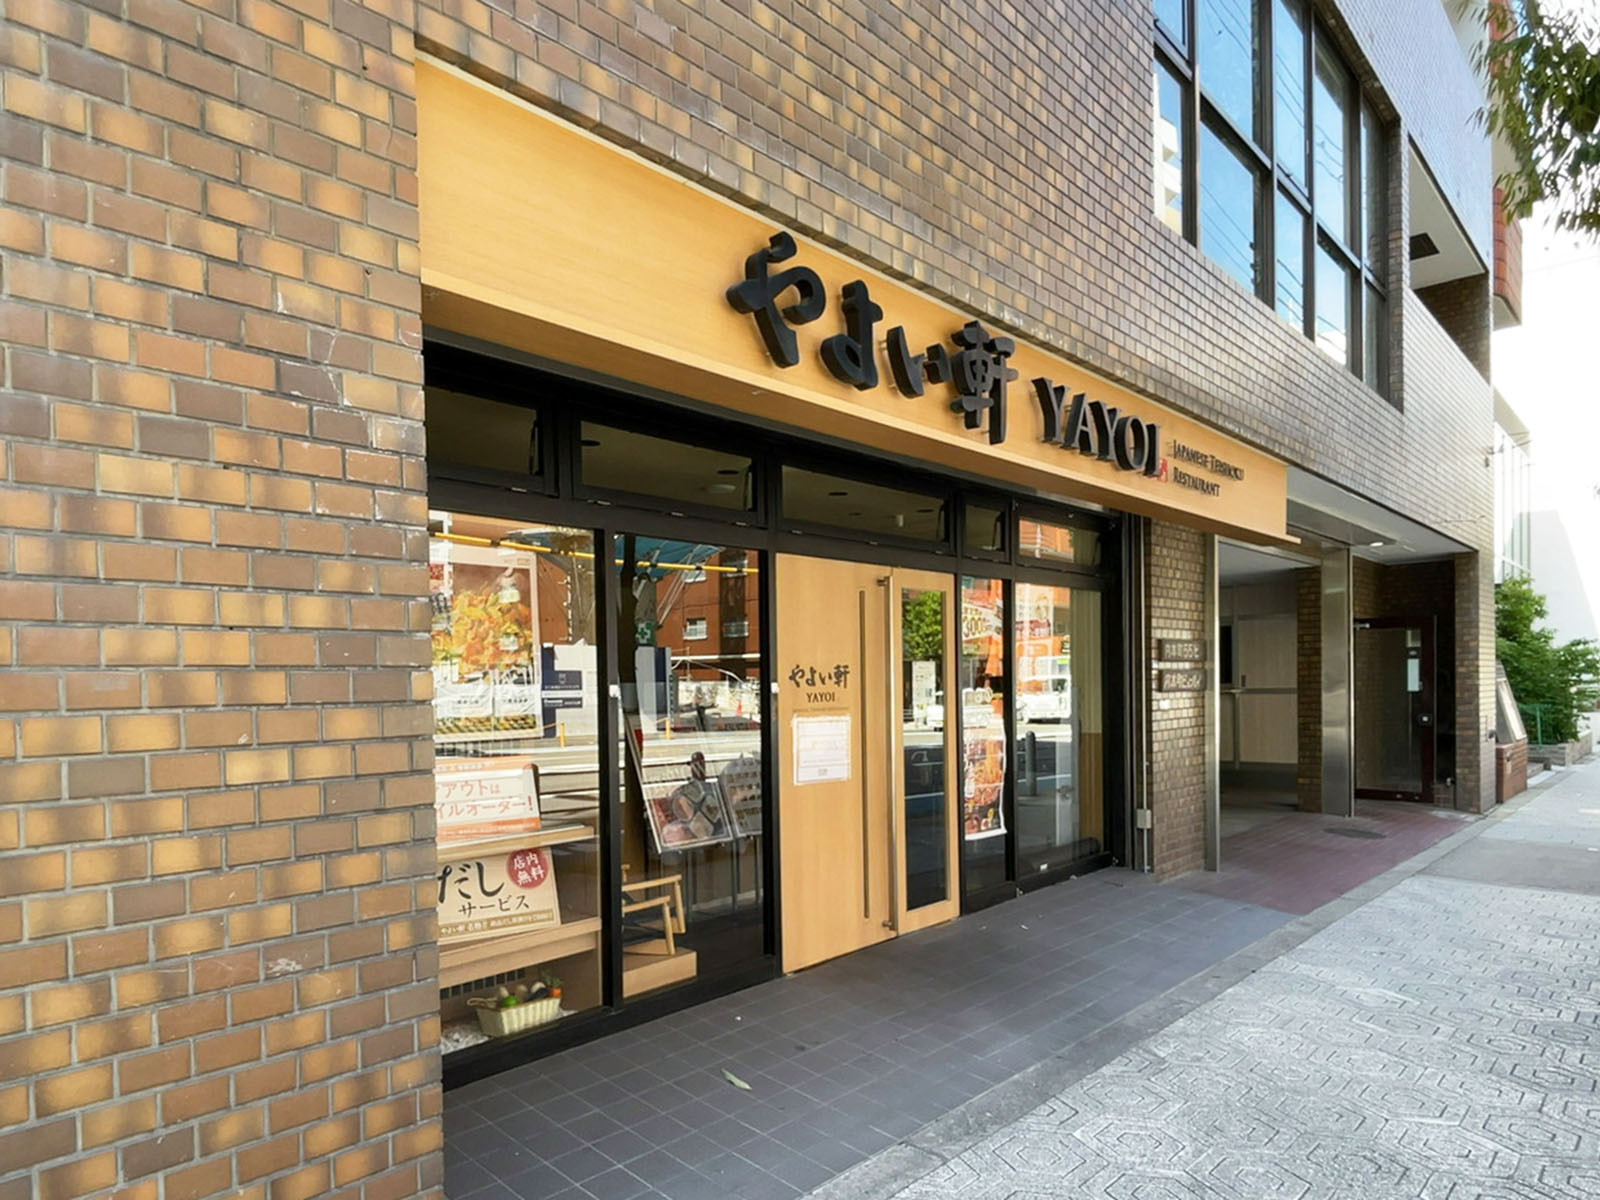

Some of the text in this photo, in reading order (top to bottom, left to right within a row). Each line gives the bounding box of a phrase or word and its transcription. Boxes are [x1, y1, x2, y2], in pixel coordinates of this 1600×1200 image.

[726, 230, 1019, 445] やよい軒
[1032, 376, 1162, 478] YAYOI
[1172, 440, 1208, 468] JAPANESE
[1172, 466, 1221, 497] RESTAURANT
[788, 664, 850, 688] やよい軒
[806, 691, 836, 703] YAYOI
[436, 780, 501, 799] アウトは
[513, 852, 539, 870] 店内
[437, 861, 505, 904] だし
[517, 865, 545, 885] 無料
[458, 895, 530, 918] サービス
